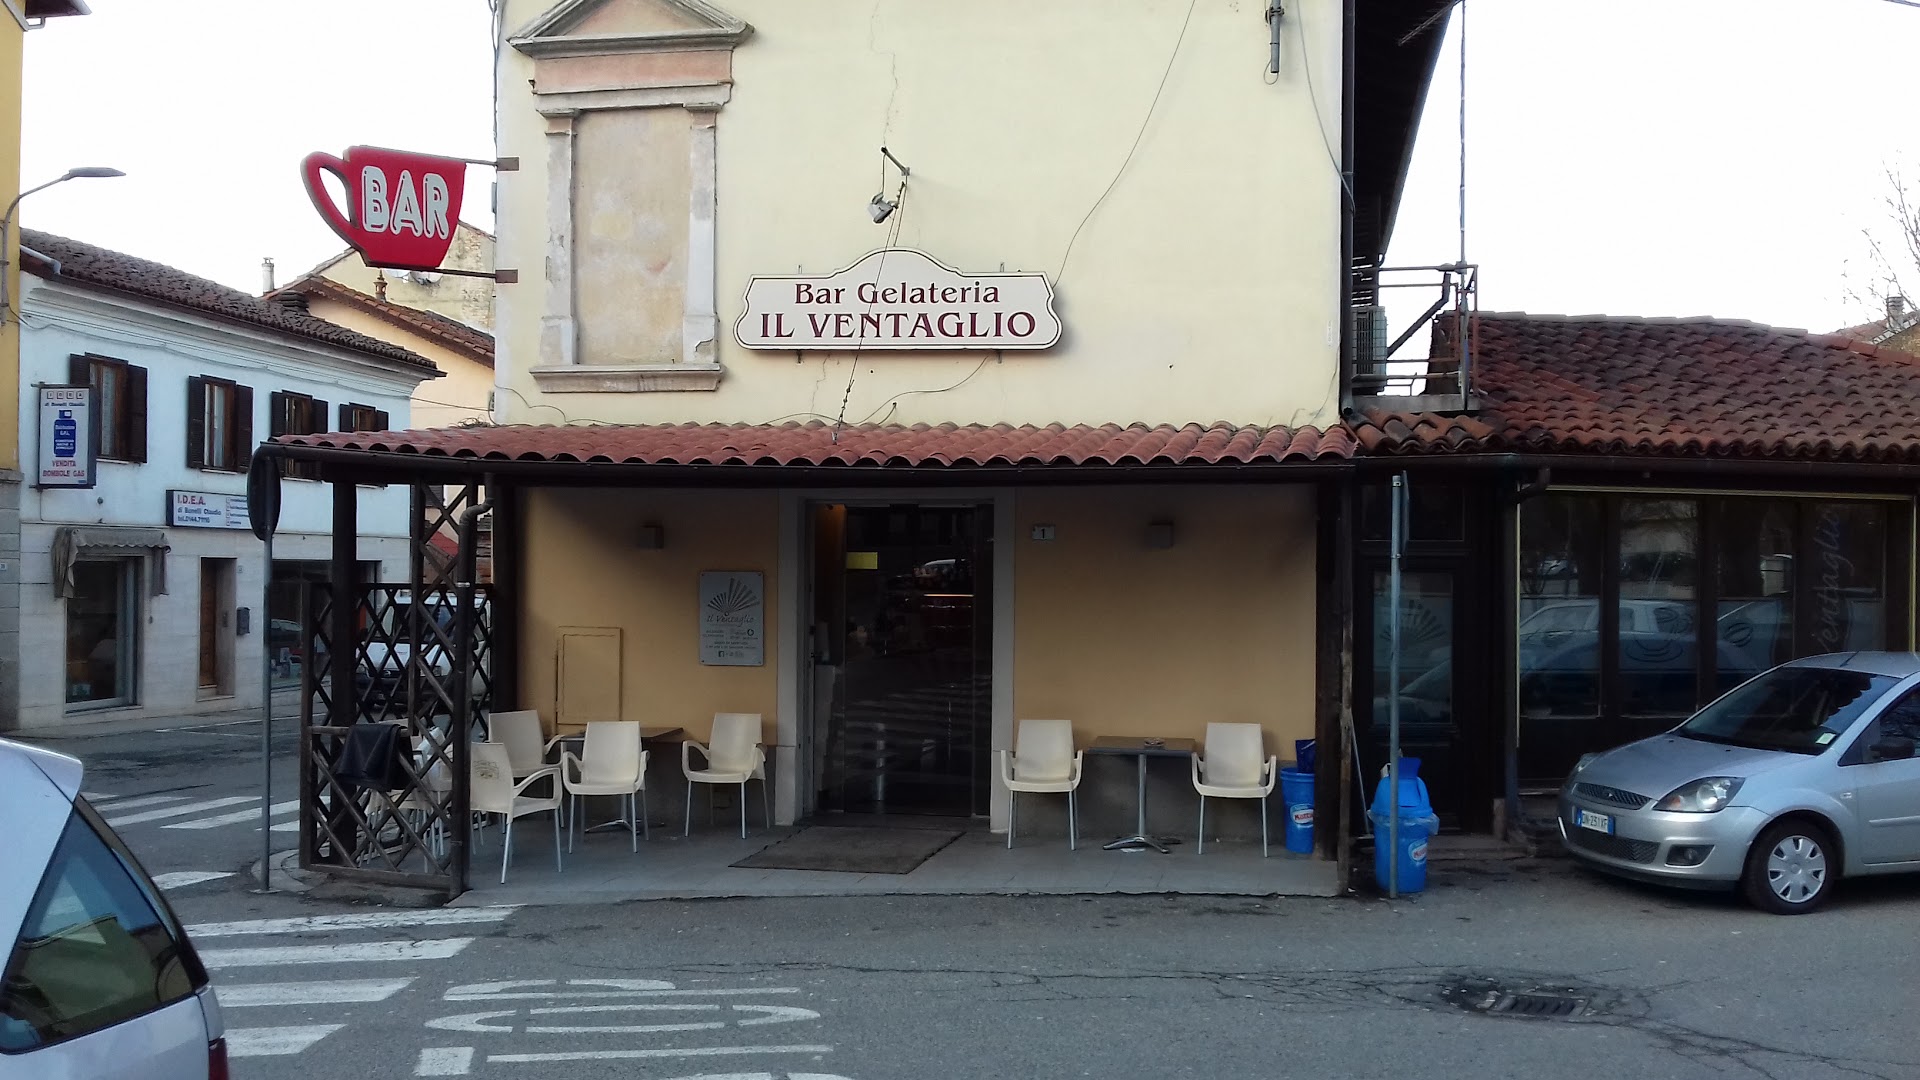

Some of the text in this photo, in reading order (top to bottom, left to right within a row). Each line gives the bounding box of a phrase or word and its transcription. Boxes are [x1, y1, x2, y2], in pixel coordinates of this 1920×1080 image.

[362, 165, 449, 240] BAR
[794, 281, 1001, 305] Bar Gelateria
[761, 311, 1036, 339] IL VENTAGLIO
[52, 460, 76, 468] VENDITA
[42, 469, 71, 477] BOMBOLE
[177, 493, 207, 506] I.D.E.A.
[1040, 528, 1046, 539] 1
